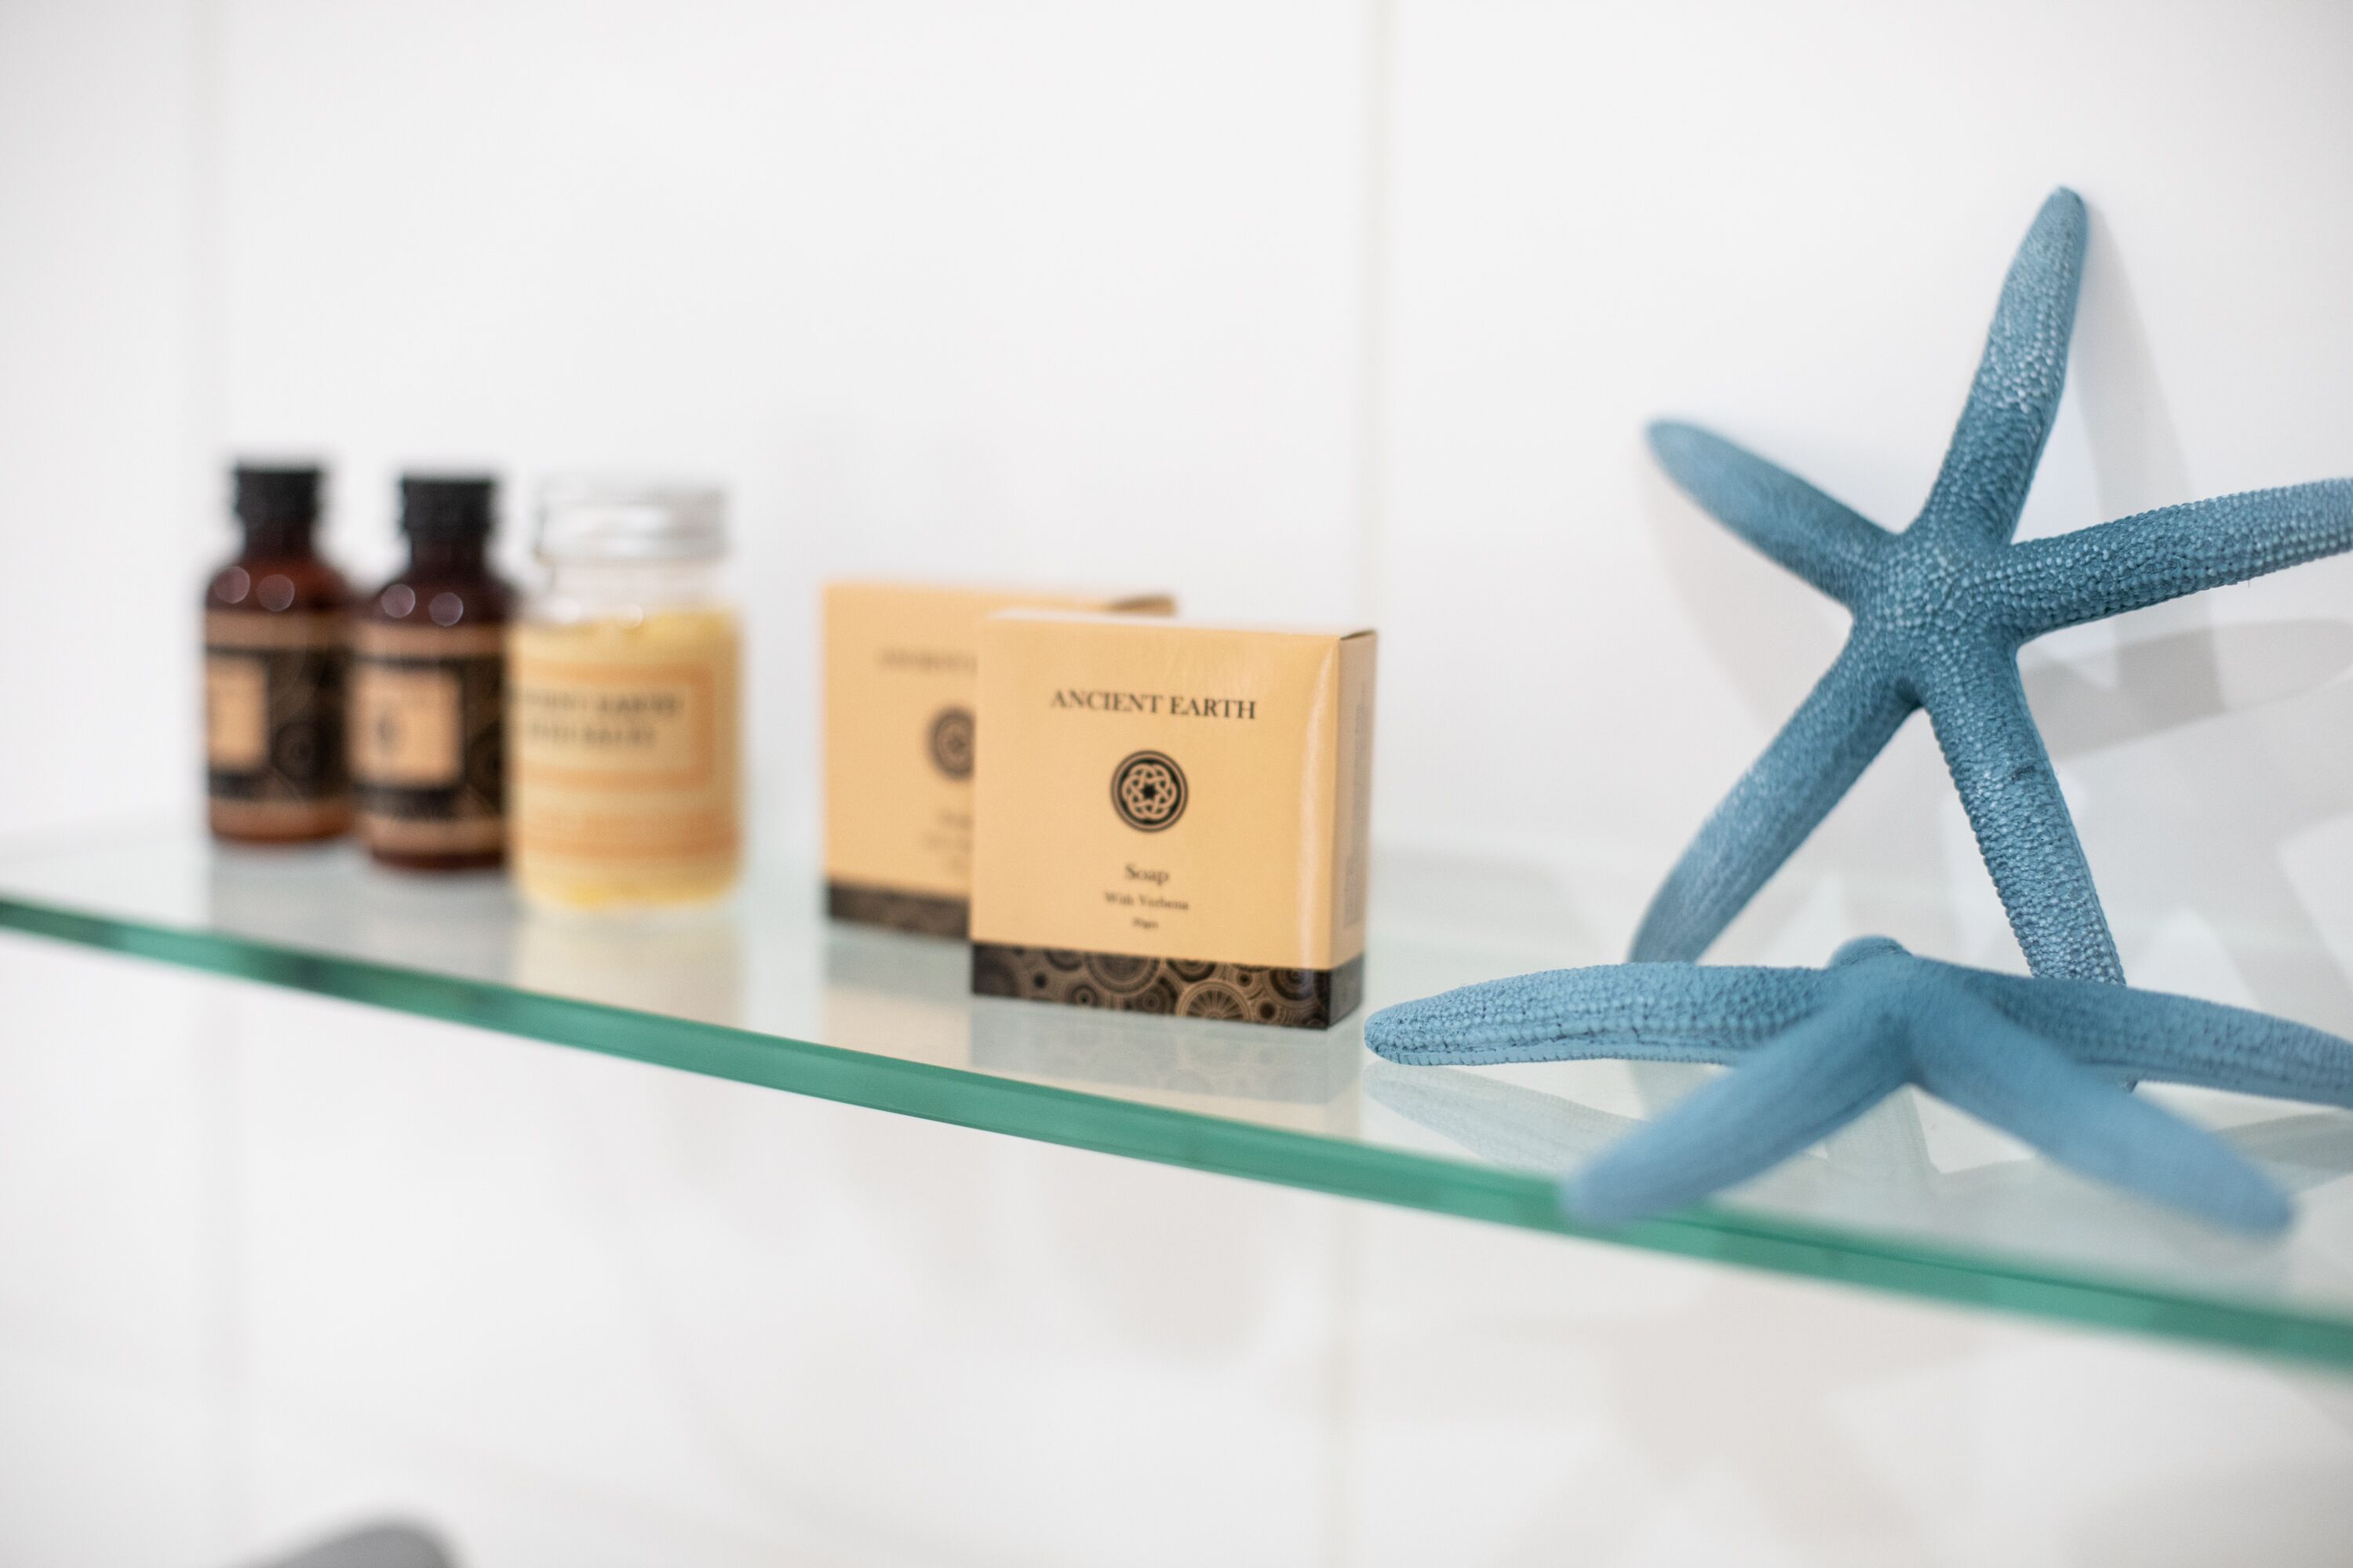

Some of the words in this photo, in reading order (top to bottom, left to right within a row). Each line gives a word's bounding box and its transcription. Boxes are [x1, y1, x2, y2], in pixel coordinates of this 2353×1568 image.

[1052, 689, 1164, 714] ANCIENT
[1168, 695, 1258, 720] EARTH
[1125, 863, 1170, 886] Soap
[1104, 891, 1135, 906] With
[1138, 893, 1189, 910] Verbena
